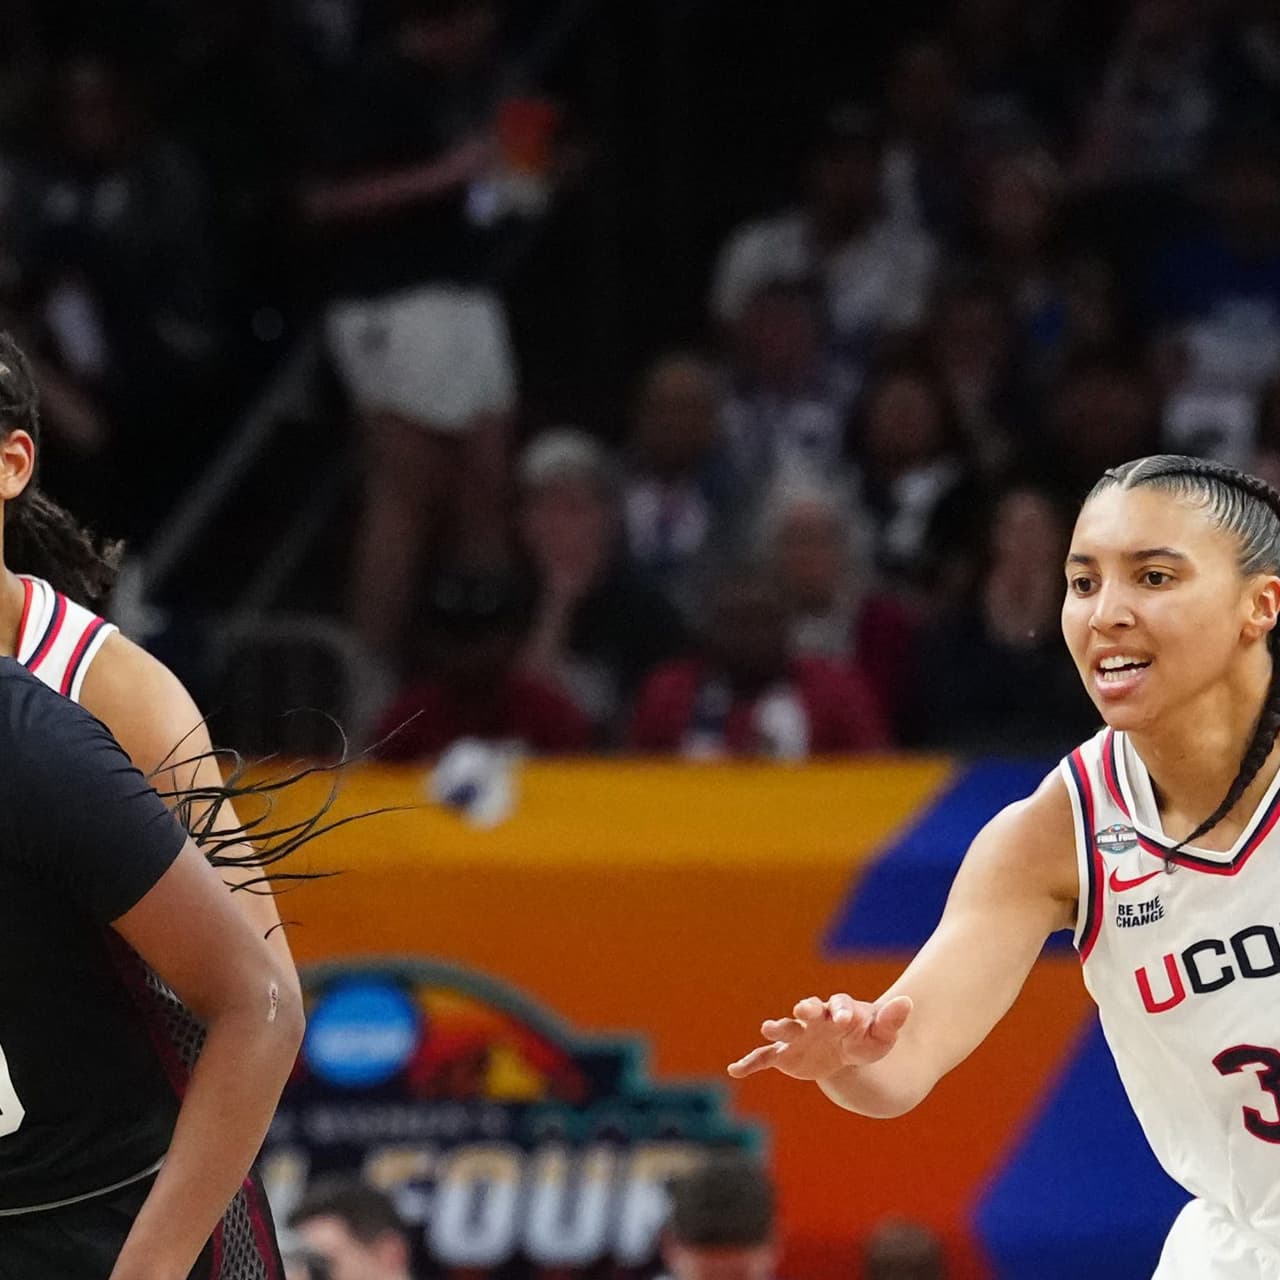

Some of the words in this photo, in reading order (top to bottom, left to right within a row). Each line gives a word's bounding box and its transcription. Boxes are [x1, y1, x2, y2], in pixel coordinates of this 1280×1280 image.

[1115, 905, 1166, 929] CHANGE
[1118, 903, 1134, 917] BE
[1137, 895, 1162, 915] THE
